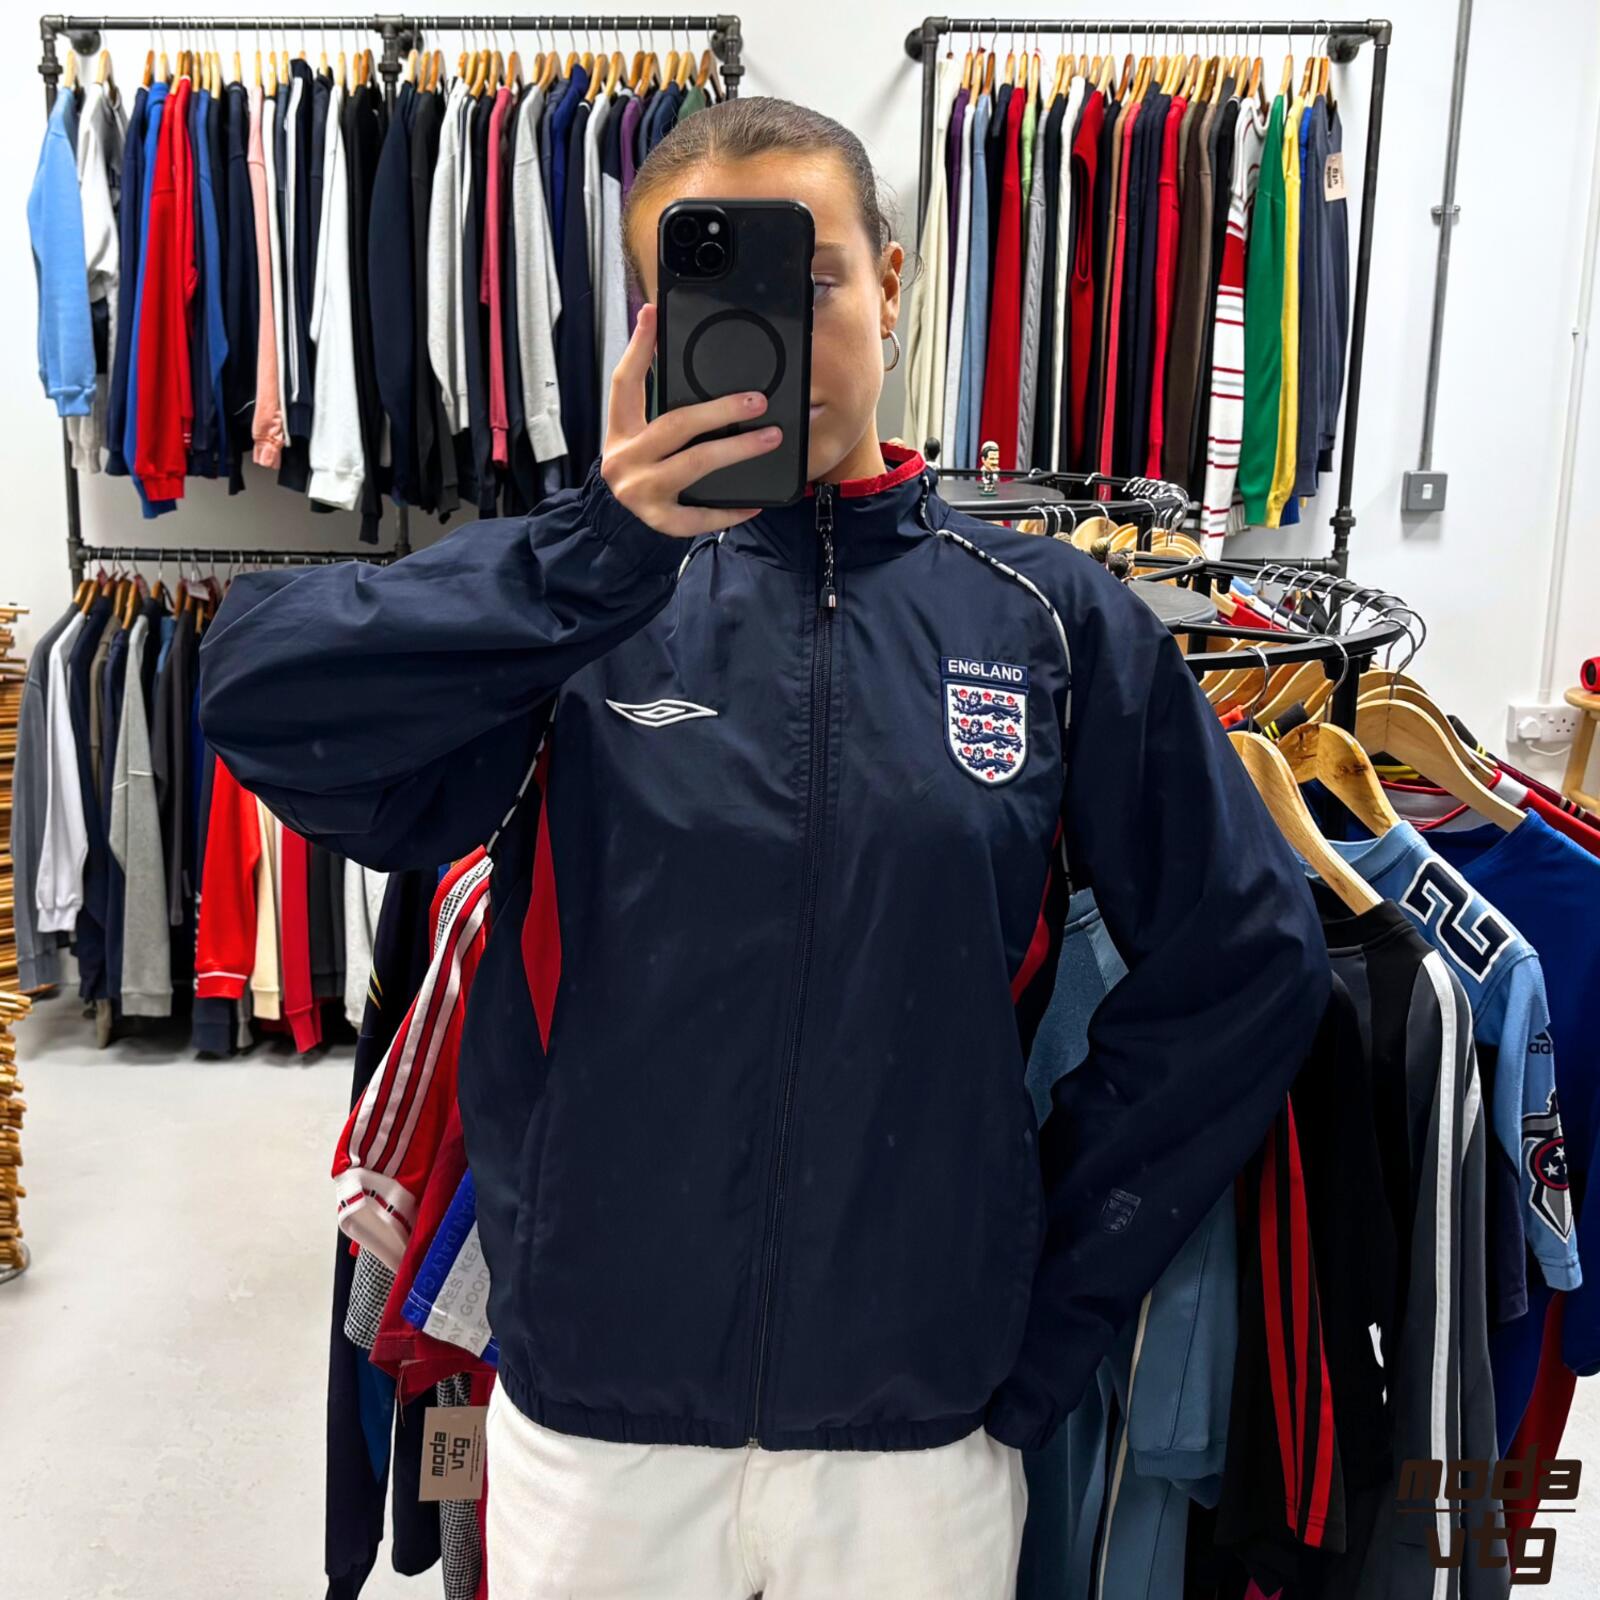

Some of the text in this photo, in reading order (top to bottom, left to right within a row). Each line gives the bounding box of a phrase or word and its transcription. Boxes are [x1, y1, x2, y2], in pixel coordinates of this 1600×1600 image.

[948, 660, 1023, 681] ENGLAND
[1399, 857, 1517, 984] 2
[429, 1431, 447, 1477] moda
[448, 1437, 471, 1470] vtg
